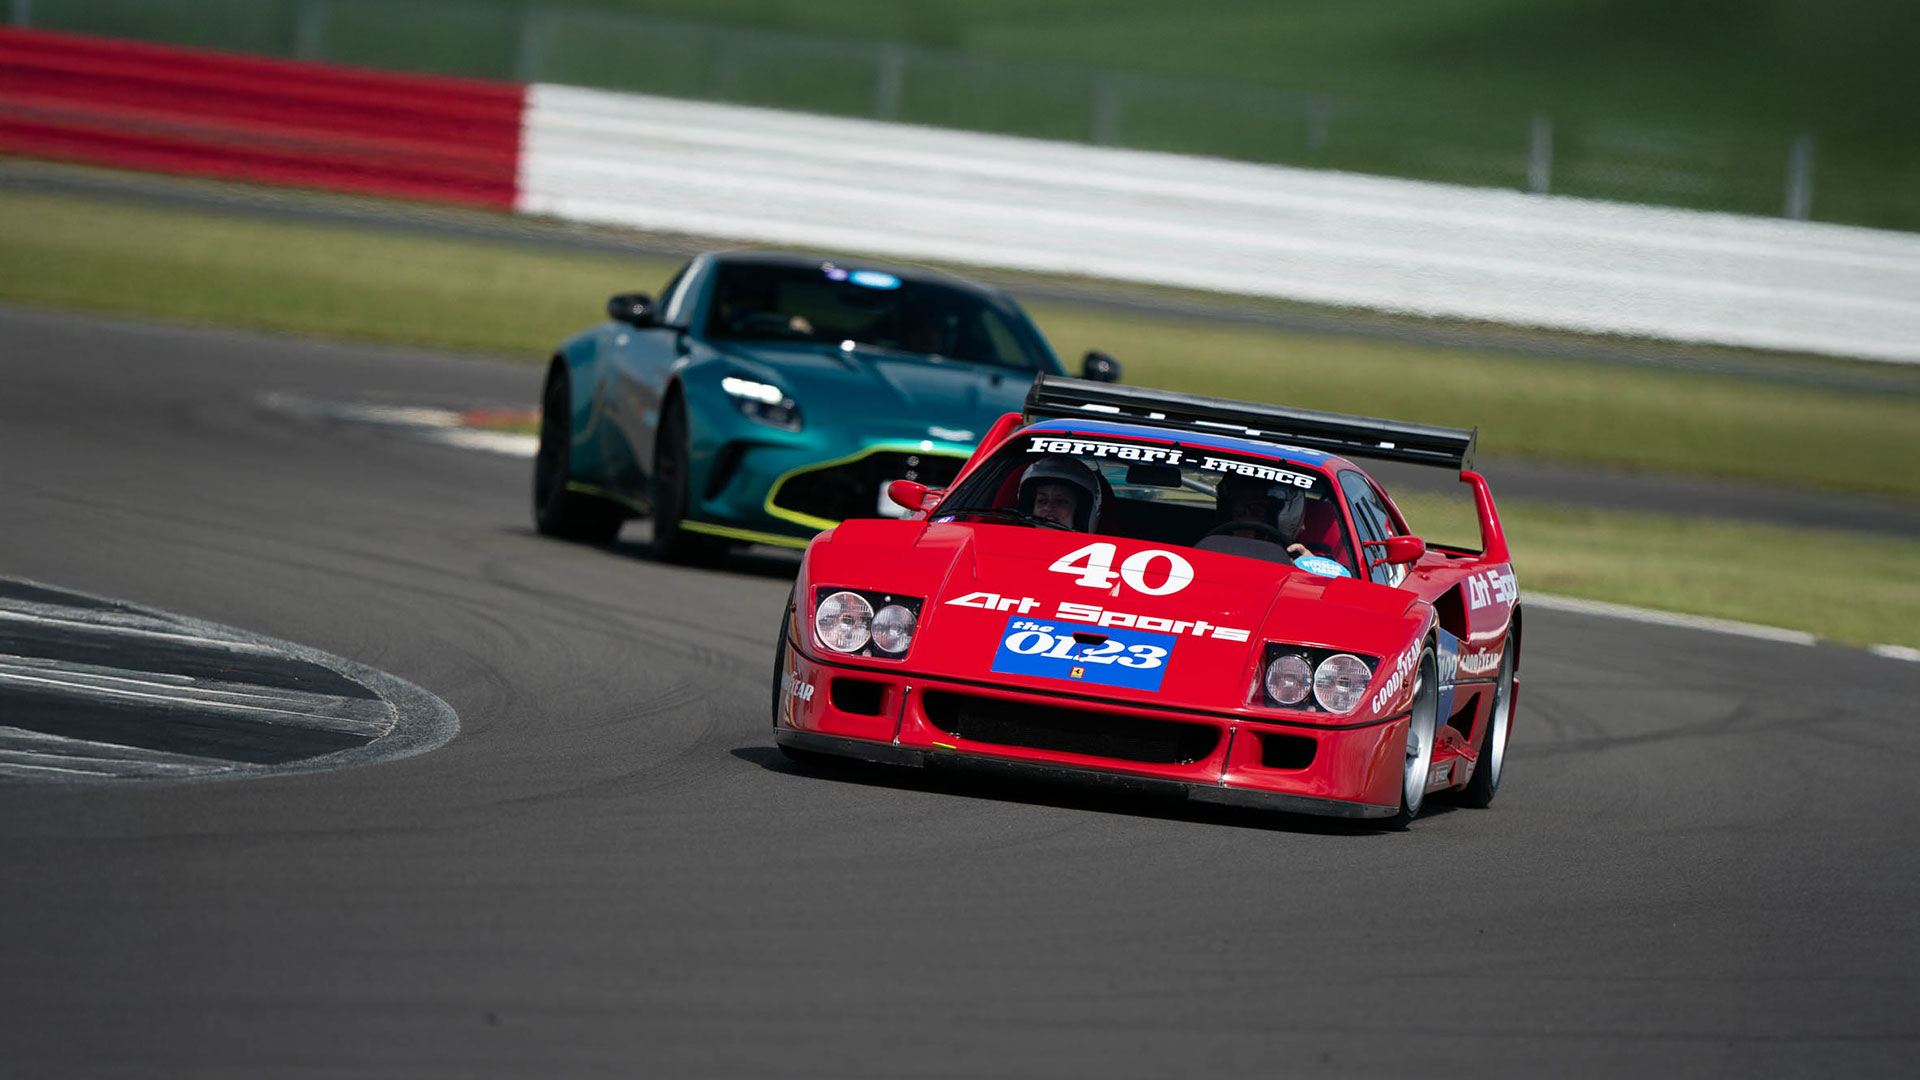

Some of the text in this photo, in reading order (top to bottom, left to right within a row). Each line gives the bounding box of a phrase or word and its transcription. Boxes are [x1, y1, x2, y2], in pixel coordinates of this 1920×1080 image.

[1026, 437, 1183, 464] Ferrari
[1200, 456, 1317, 490] France
[1048, 542, 1195, 596] 40
[1467, 573, 1492, 610] Art
[944, 591, 1251, 642] Art Sports
[1011, 620, 1055, 633] the
[1372, 638, 1421, 714] GOODYEAR
